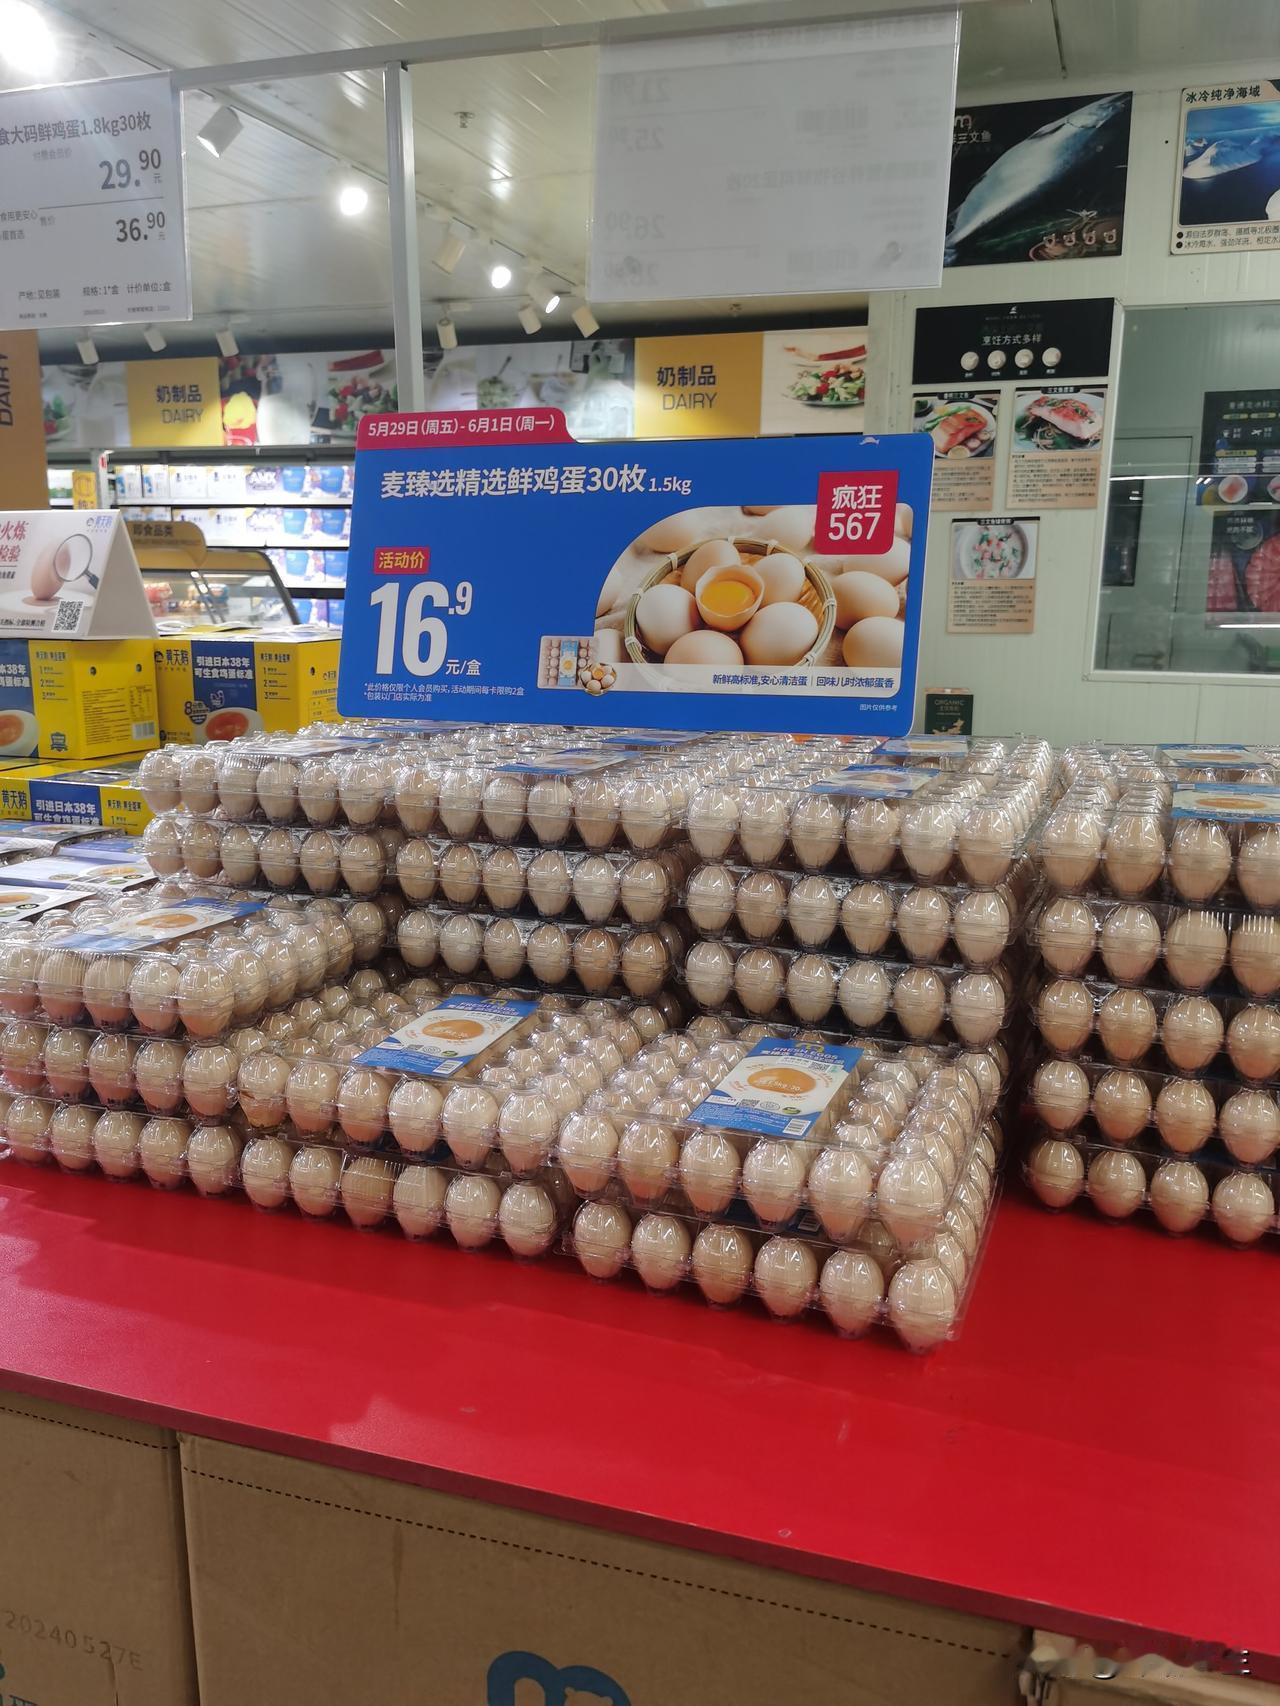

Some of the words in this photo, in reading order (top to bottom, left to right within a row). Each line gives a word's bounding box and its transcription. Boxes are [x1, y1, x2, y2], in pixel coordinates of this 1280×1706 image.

[1186, 85, 1261, 103] 冰冷纯净海域
[657, 365, 716, 387] 奶制品
[157, 384, 202, 403] 奶制品
[663, 393, 717, 410] DAIRY
[162, 408, 203, 424] DAIRY
[381, 463, 647, 498] 麦臻选精选鲜鸡蛋30枚
[649, 476, 692, 495] 1.5kg
[831, 484, 883, 510] 疯狂
[828, 512, 880, 541] 567
[378, 551, 425, 570] 活动价
[446, 658, 481, 675] 元/盒
